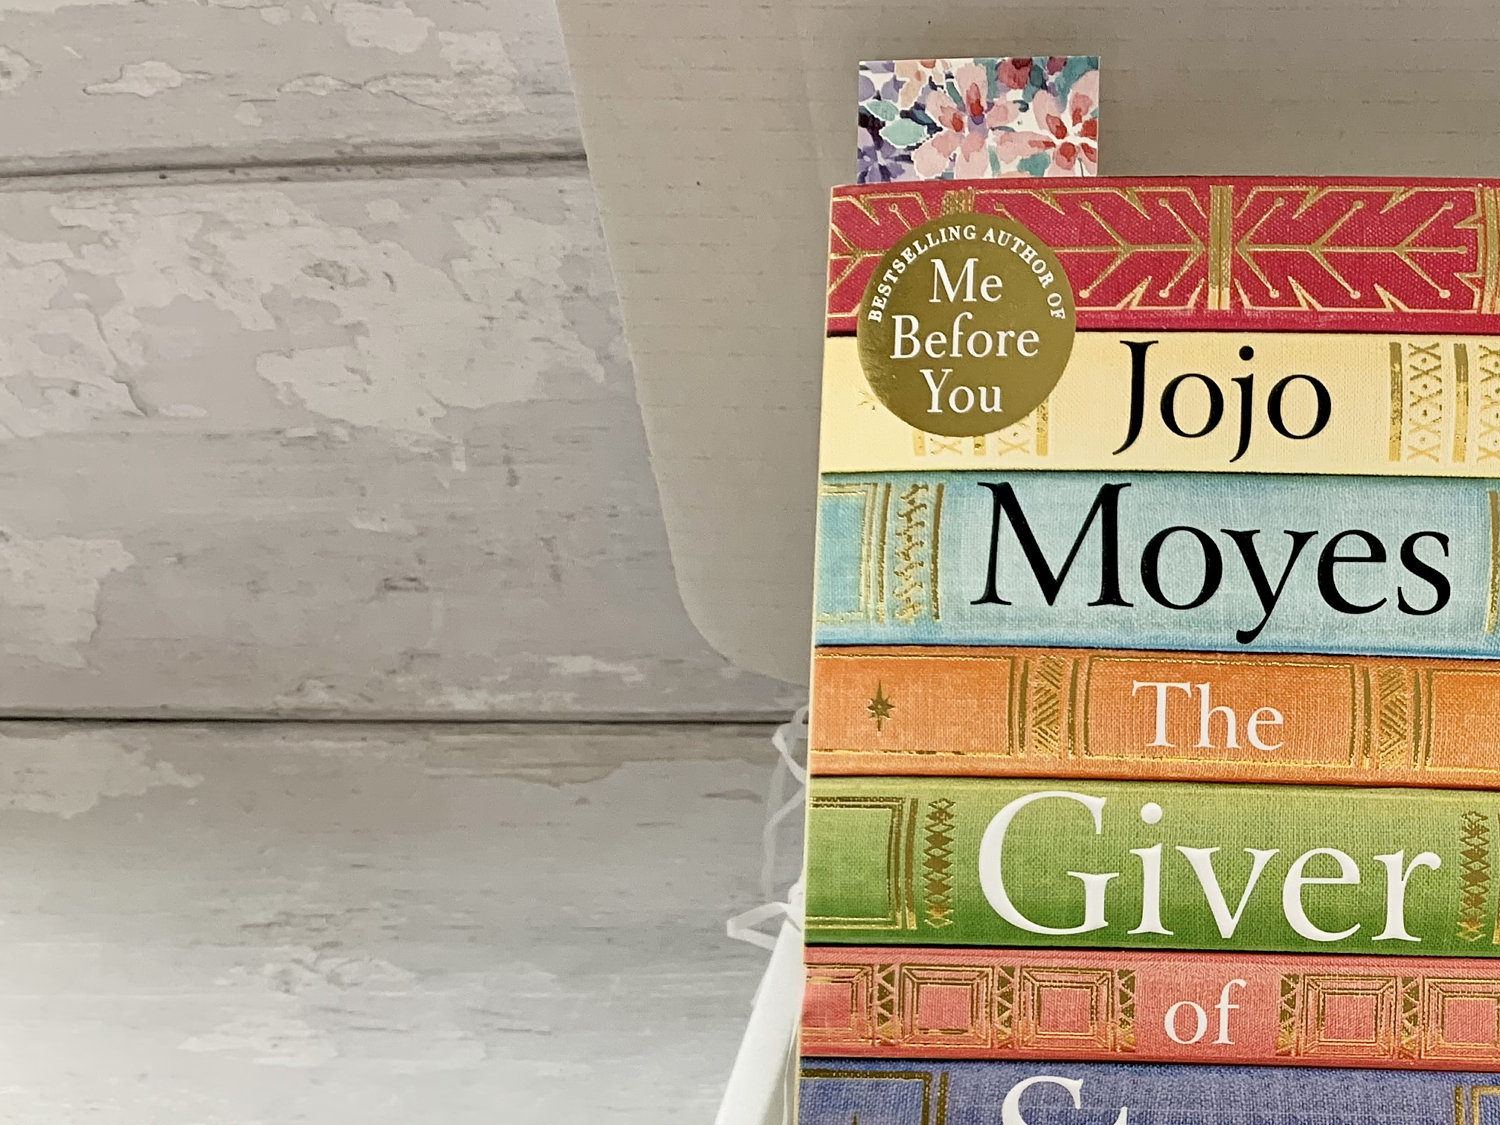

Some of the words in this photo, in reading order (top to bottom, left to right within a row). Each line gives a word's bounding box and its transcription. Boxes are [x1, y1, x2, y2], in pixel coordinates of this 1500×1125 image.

[868, 225, 976, 323] BESTSELLING
[982, 227, 1054, 288] AUTHOR
[1047, 292, 1066, 320] OF
[929, 258, 1003, 303] Me
[889, 311, 1040, 359] Before
[919, 368, 1003, 413] You
[1112, 340, 1332, 462] Jojo
[970, 481, 1453, 644] Moyes
[1130, 680, 1285, 752] The
[977, 790, 1443, 942] Giver
[1163, 979, 1247, 1046] of
